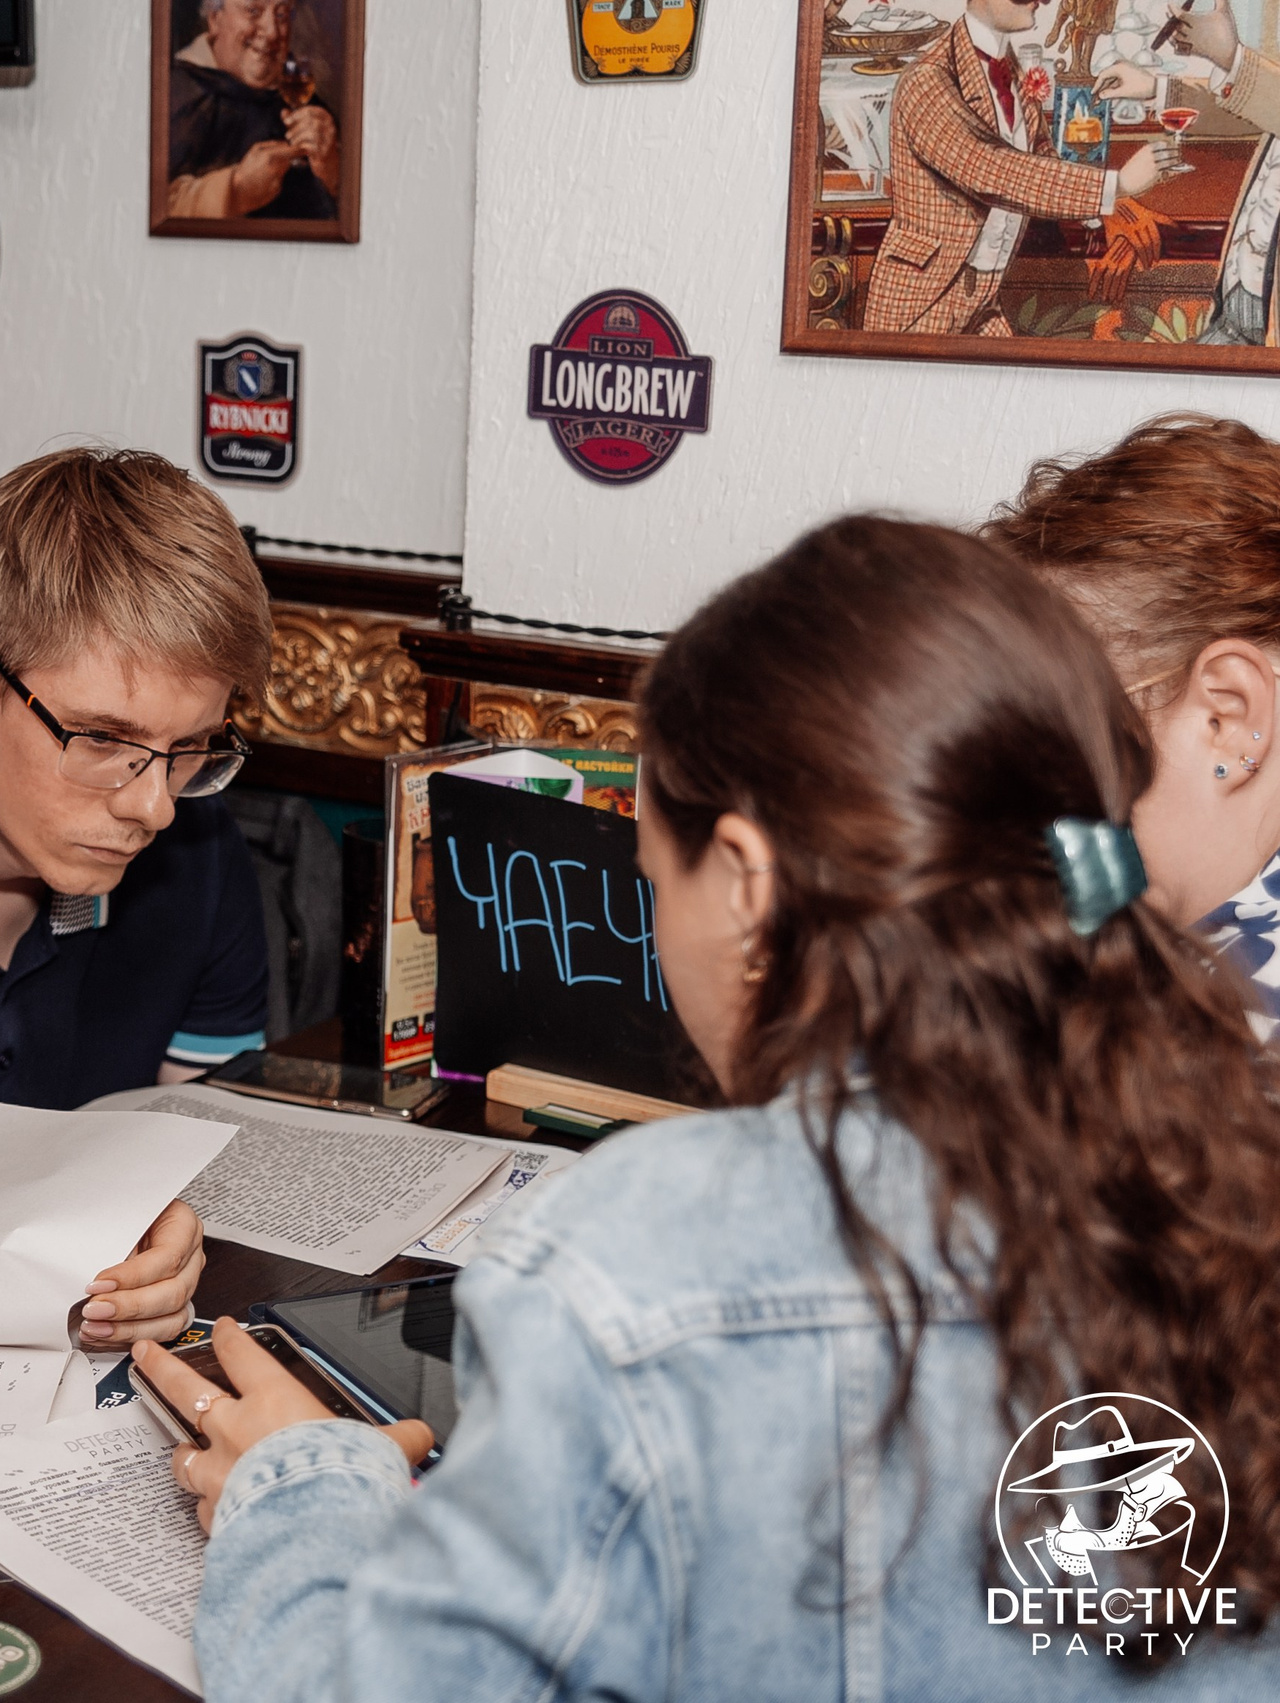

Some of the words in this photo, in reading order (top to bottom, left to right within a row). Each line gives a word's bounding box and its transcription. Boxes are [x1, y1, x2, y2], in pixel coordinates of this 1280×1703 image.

[593, 340, 648, 356] LION
[541, 351, 696, 419] LONGBREW
[577, 421, 655, 444] LAGER
[64, 1424, 152, 1453] DETECTIVE
[89, 1439, 144, 1458] PARTY
[155, 1451, 173, 1461] полу
